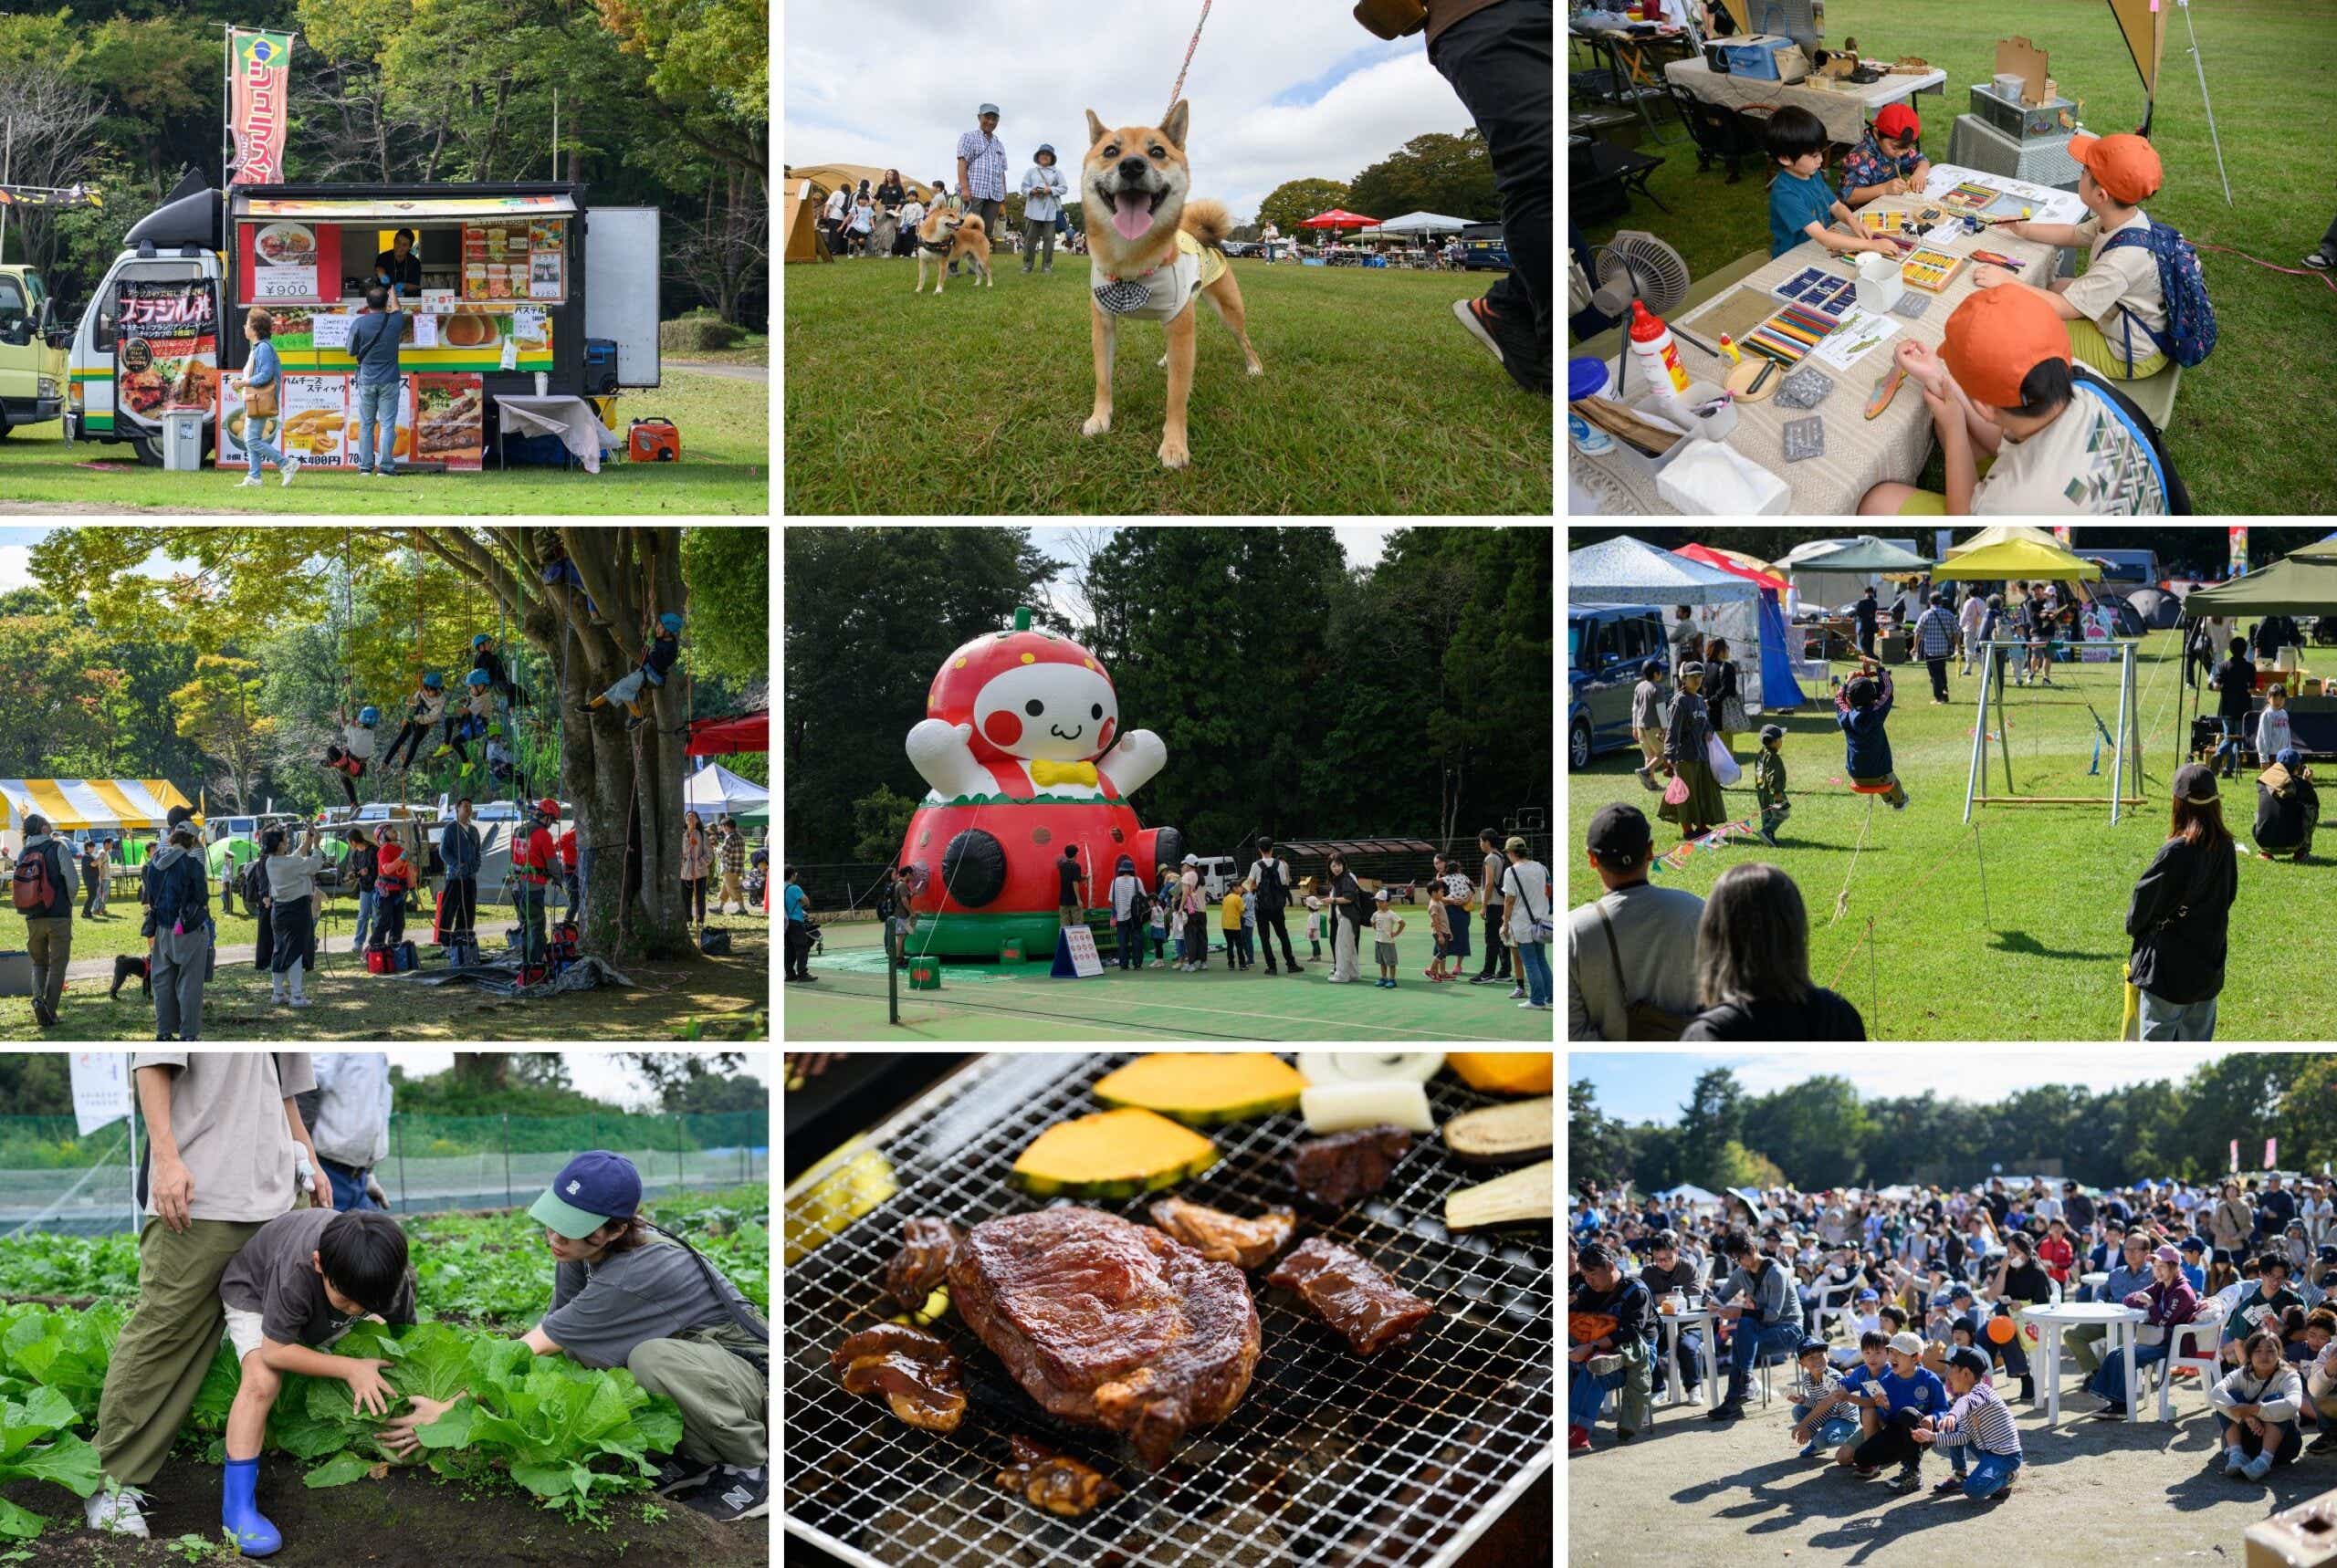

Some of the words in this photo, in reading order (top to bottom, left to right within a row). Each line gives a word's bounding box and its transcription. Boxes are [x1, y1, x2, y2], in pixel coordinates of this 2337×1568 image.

[265, 285, 308, 296] ¥900
[307, 384, 346, 392] スティック
[721, 1484, 755, 1511] N
